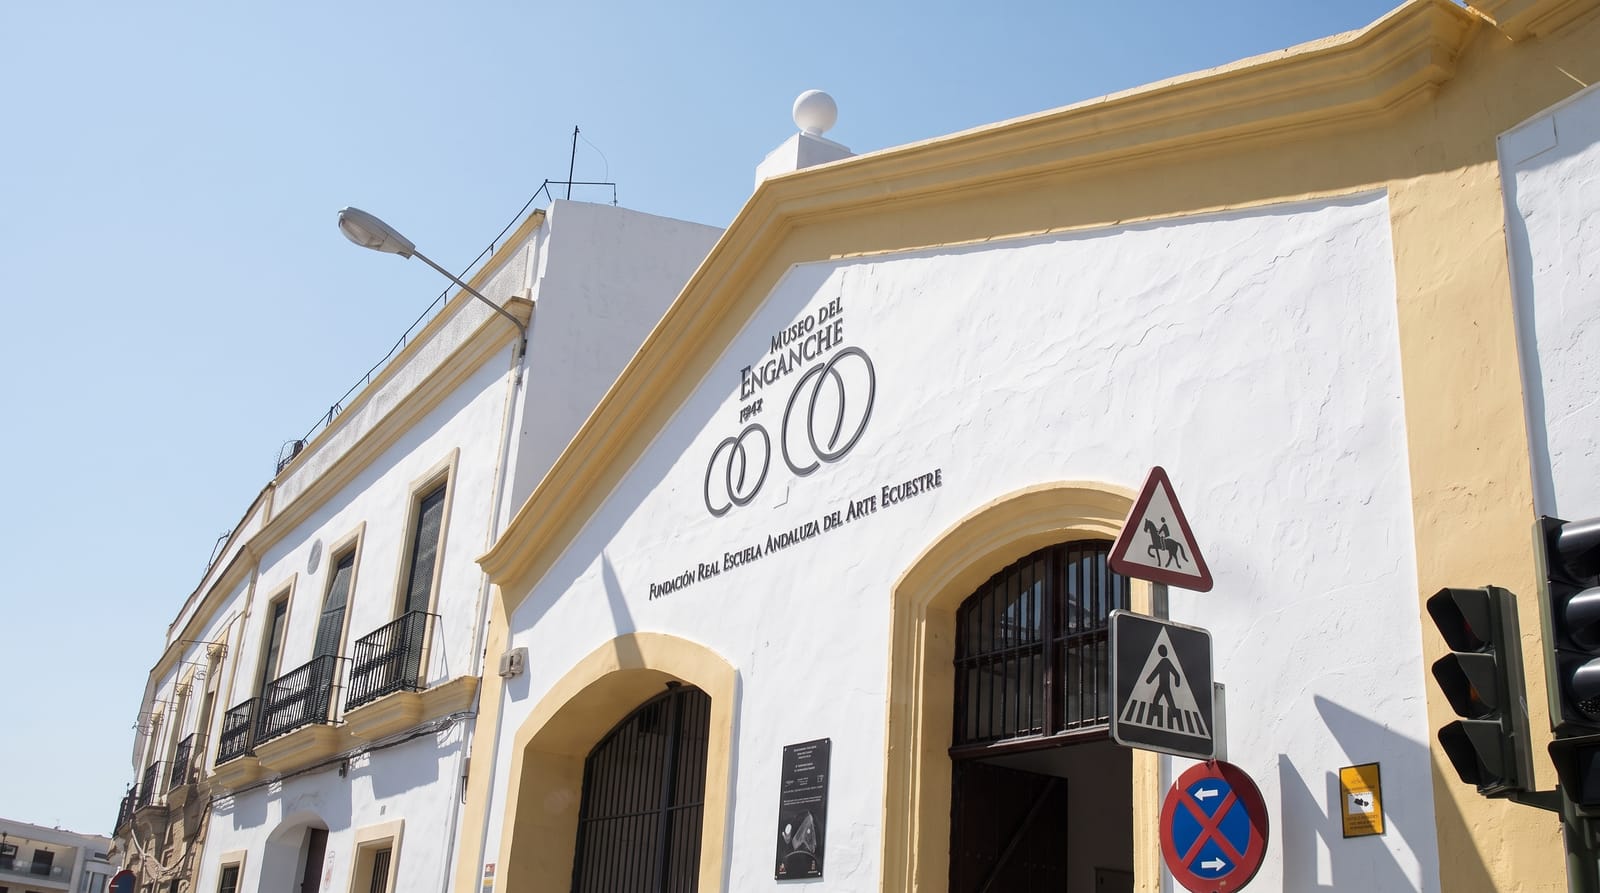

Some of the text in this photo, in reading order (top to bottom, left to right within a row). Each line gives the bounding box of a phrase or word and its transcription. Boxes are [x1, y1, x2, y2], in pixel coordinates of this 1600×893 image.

[739, 318, 843, 401] ENGANCHE
[770, 297, 843, 354] MUSEO DEL
[649, 468, 943, 601] FUNDACIÓN REAL ESCUELA ANDALUZA DEL ARTE ECUESTRE
